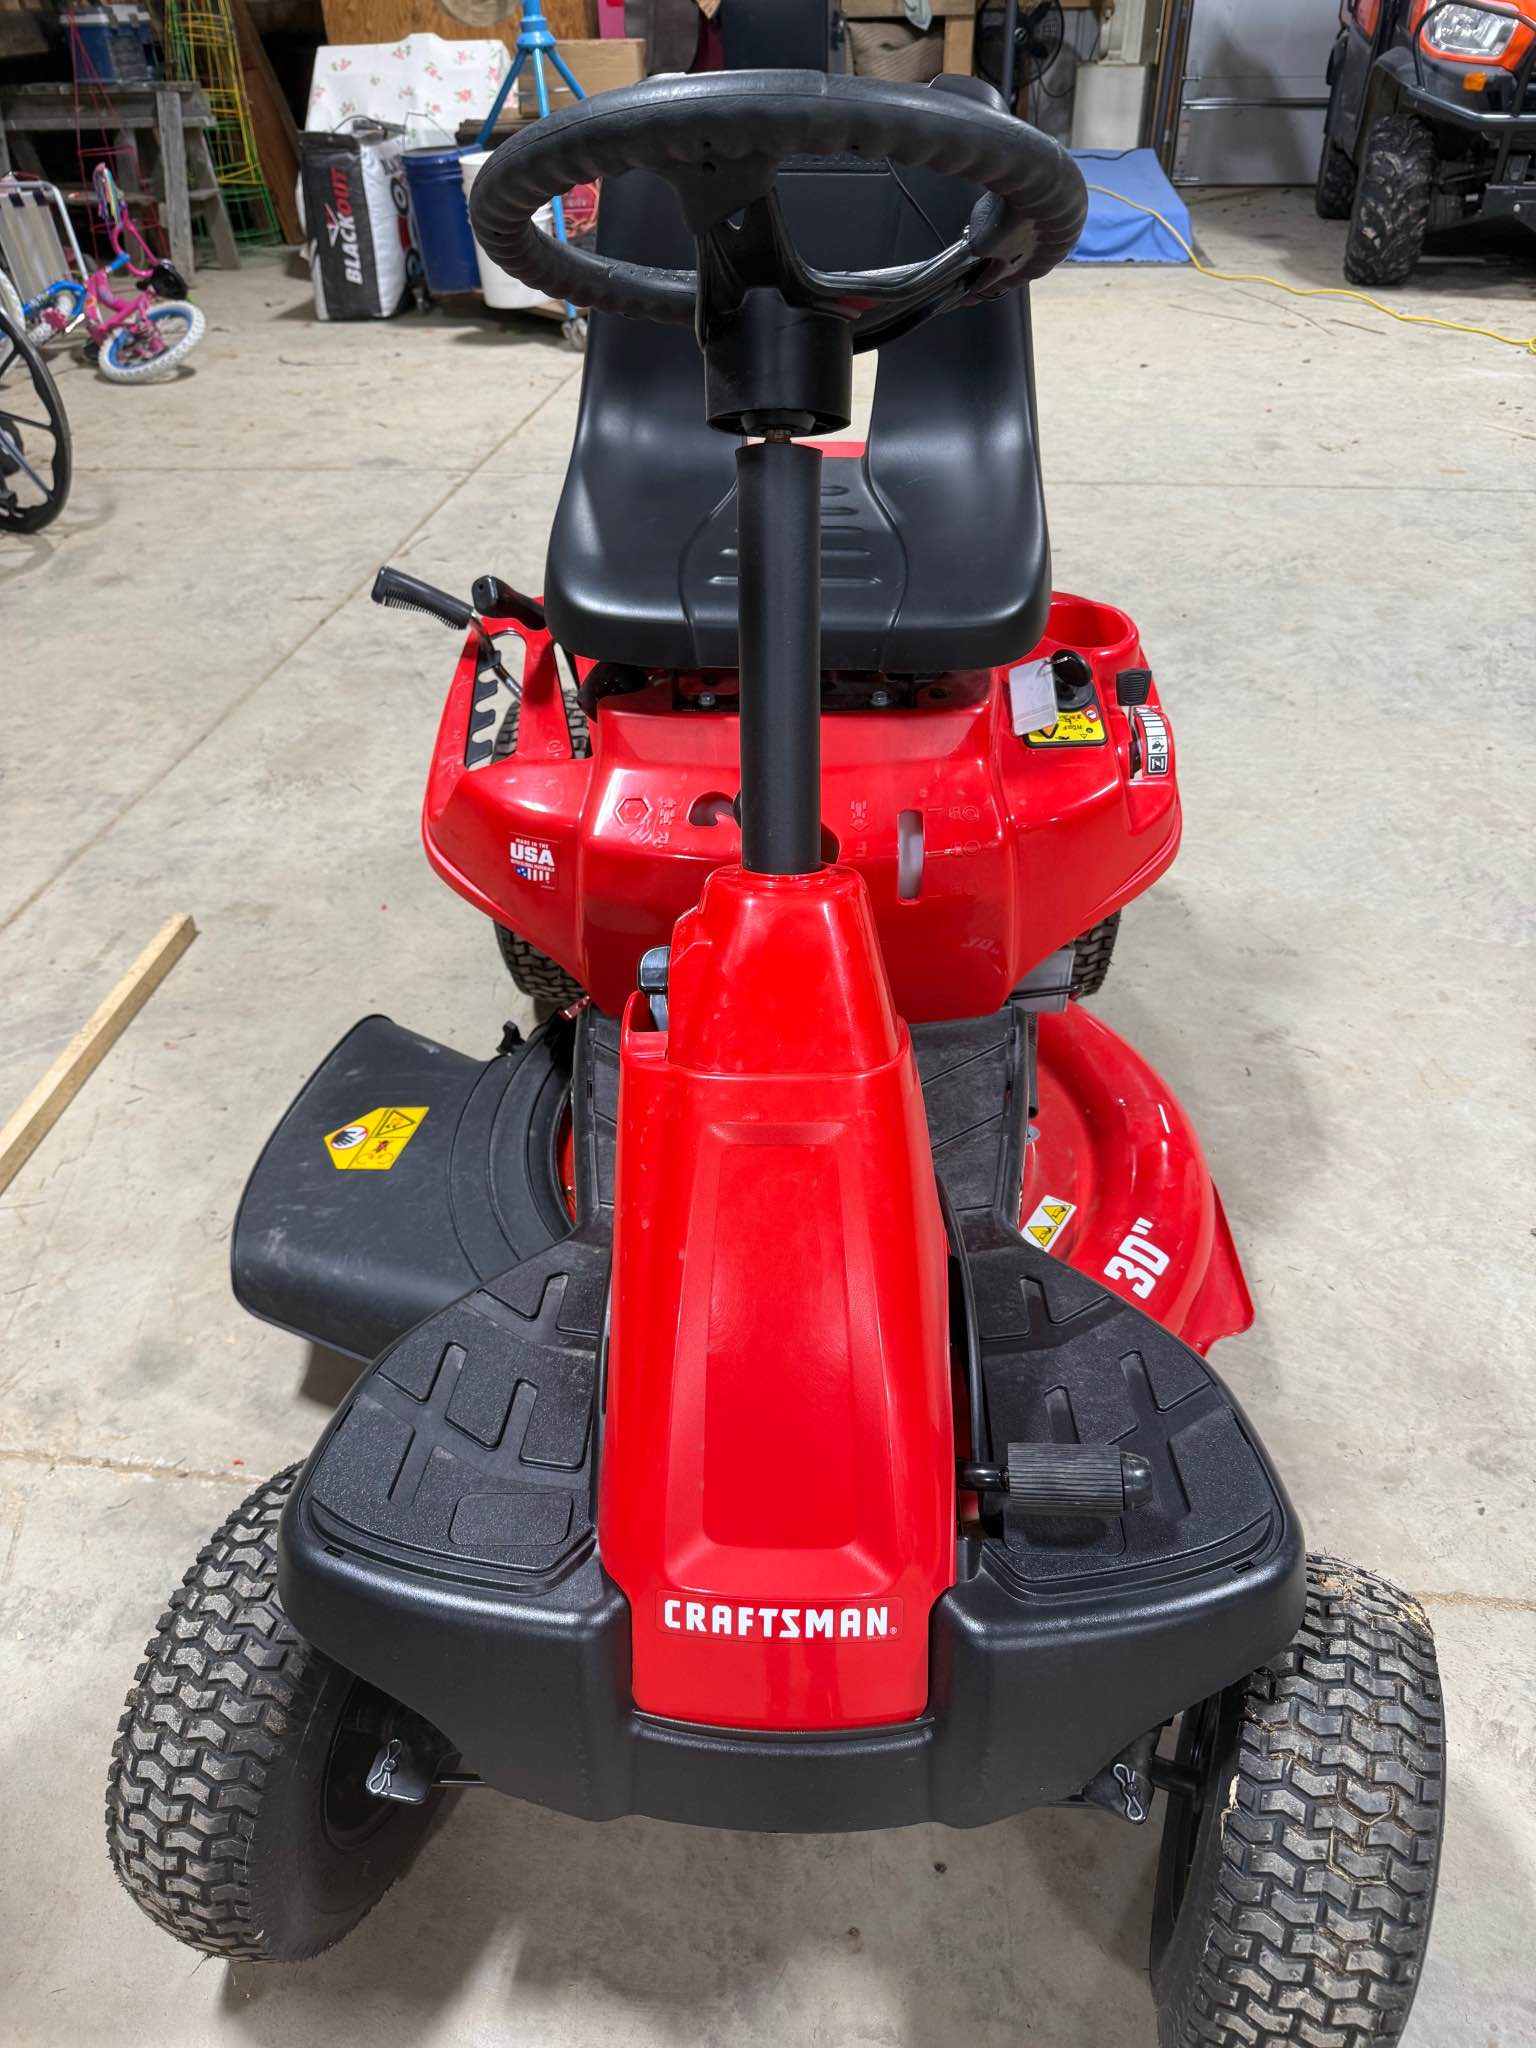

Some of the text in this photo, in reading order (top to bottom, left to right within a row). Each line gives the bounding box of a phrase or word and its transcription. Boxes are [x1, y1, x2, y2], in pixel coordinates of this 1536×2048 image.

[329, 167, 363, 285] BLACKOUT
[510, 841, 555, 867] USA
[515, 837, 530, 846] MADE
[664, 1599, 888, 1639] CRAFTSMAN
